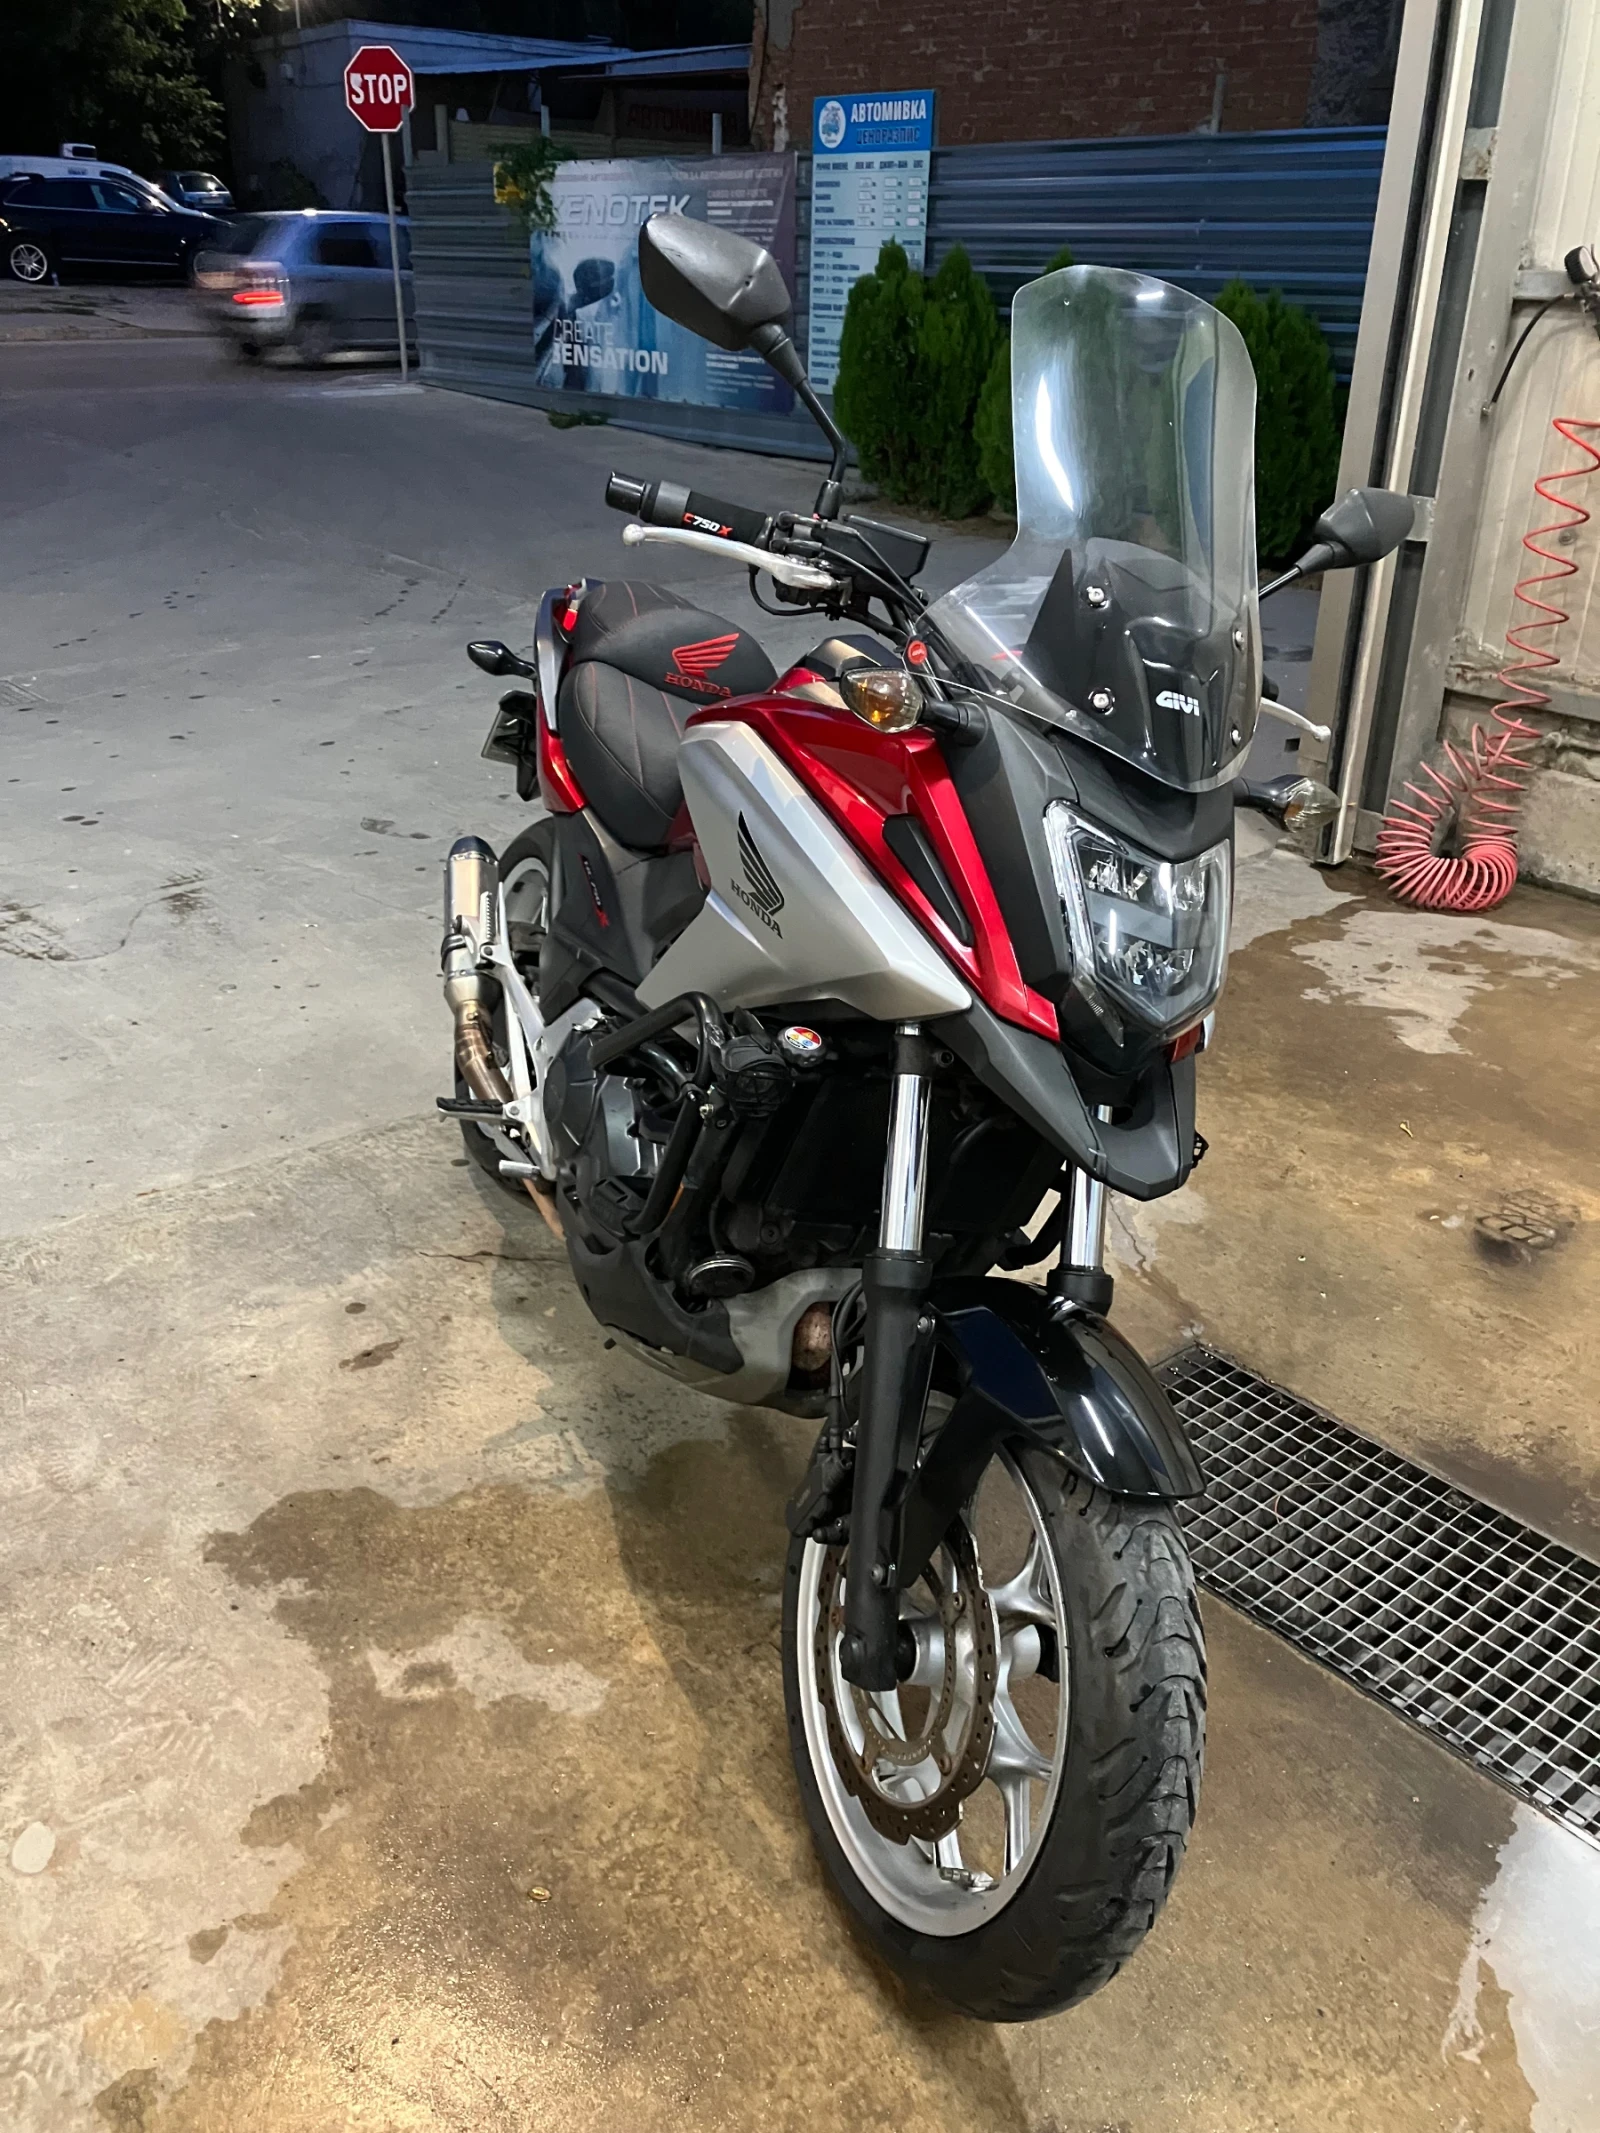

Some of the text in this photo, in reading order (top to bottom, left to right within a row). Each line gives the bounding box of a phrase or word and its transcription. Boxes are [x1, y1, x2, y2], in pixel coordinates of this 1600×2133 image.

[350, 73, 407, 105] STOP
[851, 99, 926, 123] АВТОМИВКА
[553, 319, 614, 346] CREATE
[553, 342, 668, 375] SENSATION
[663, 671, 734, 698] HONDA
[1155, 690, 1199, 717] GIVI
[730, 876, 784, 940] HONDA
